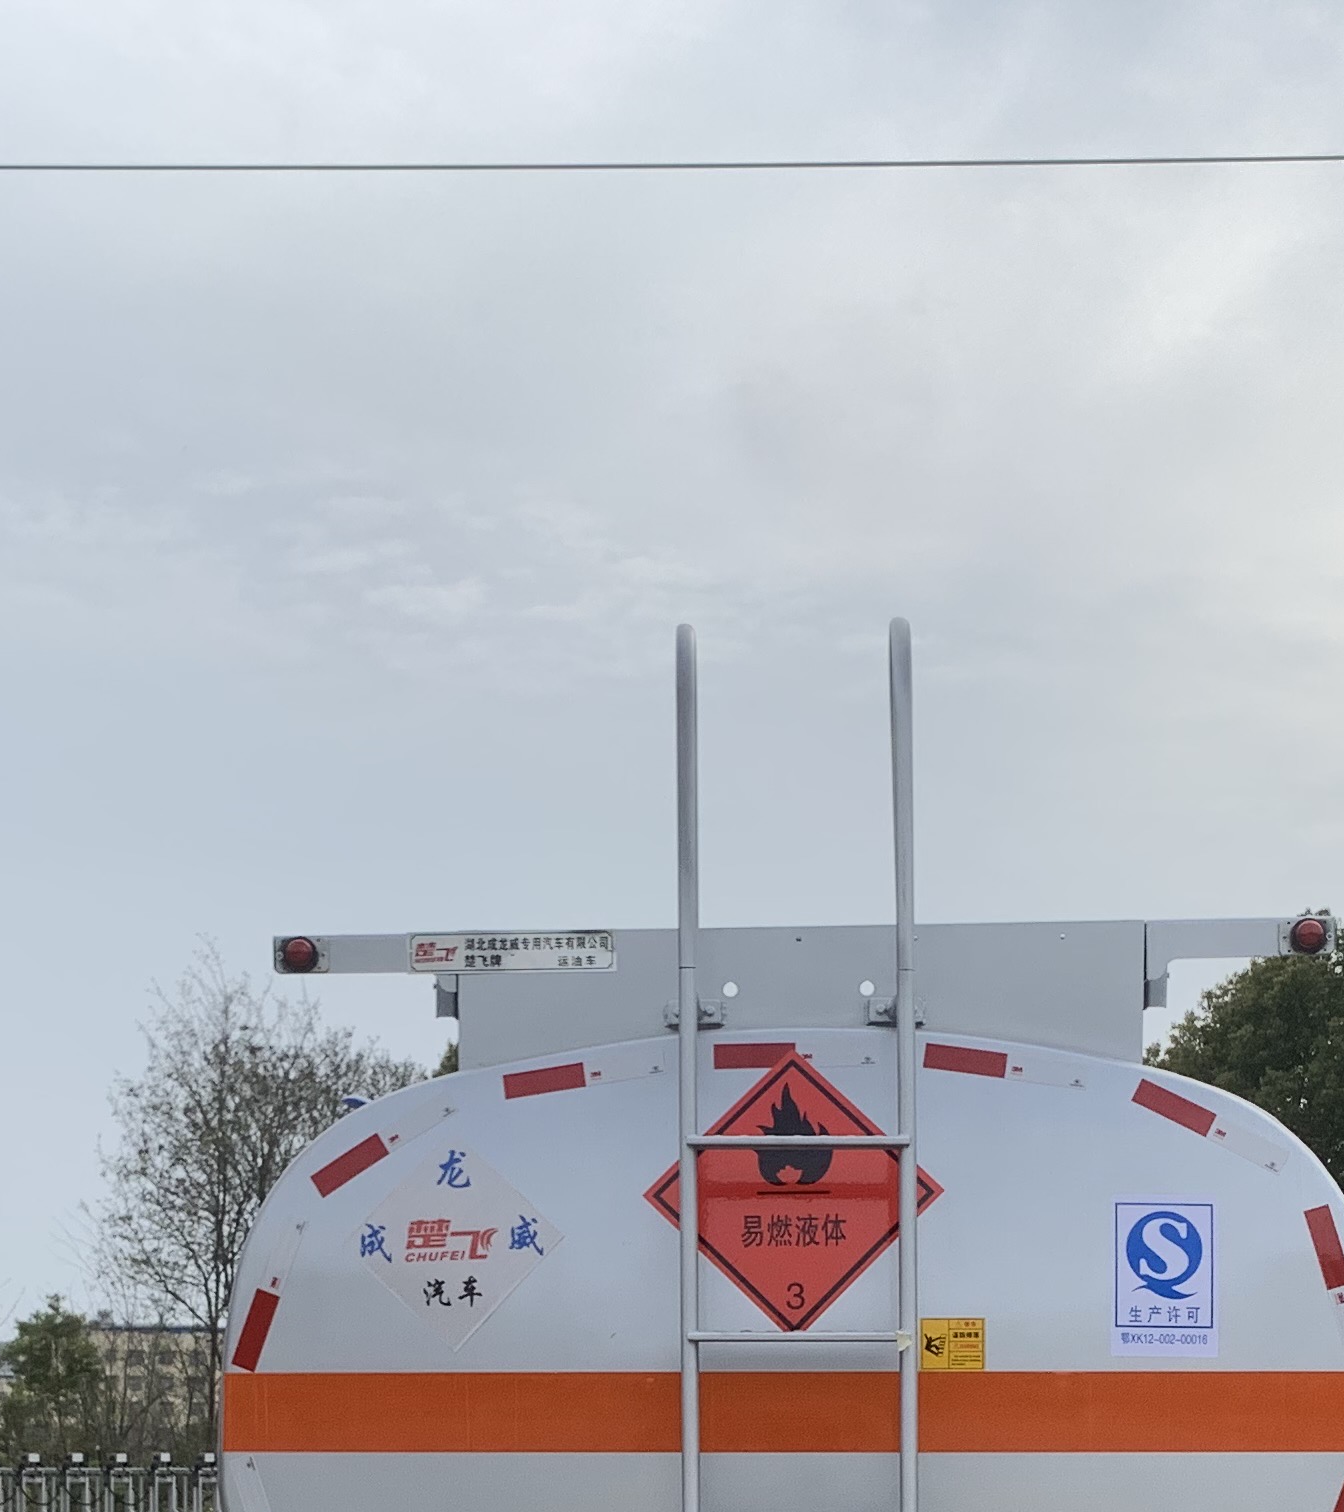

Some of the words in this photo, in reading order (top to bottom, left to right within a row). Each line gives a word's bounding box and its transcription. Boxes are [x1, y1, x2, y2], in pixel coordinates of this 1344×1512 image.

[464, 954, 502, 968] 楚飞牌
[557, 955, 597, 967] 运油车
[436, 1149, 472, 1189] 龙
[359, 1222, 393, 1264] 成
[508, 1213, 544, 1257] 威
[740, 1213, 847, 1248] 易燃液体
[404, 1250, 466, 1263] CHUFEI
[423, 1275, 483, 1308] 汽车
[786, 1282, 805, 1310] 3
[1128, 1305, 1201, 1324] 生产许可
